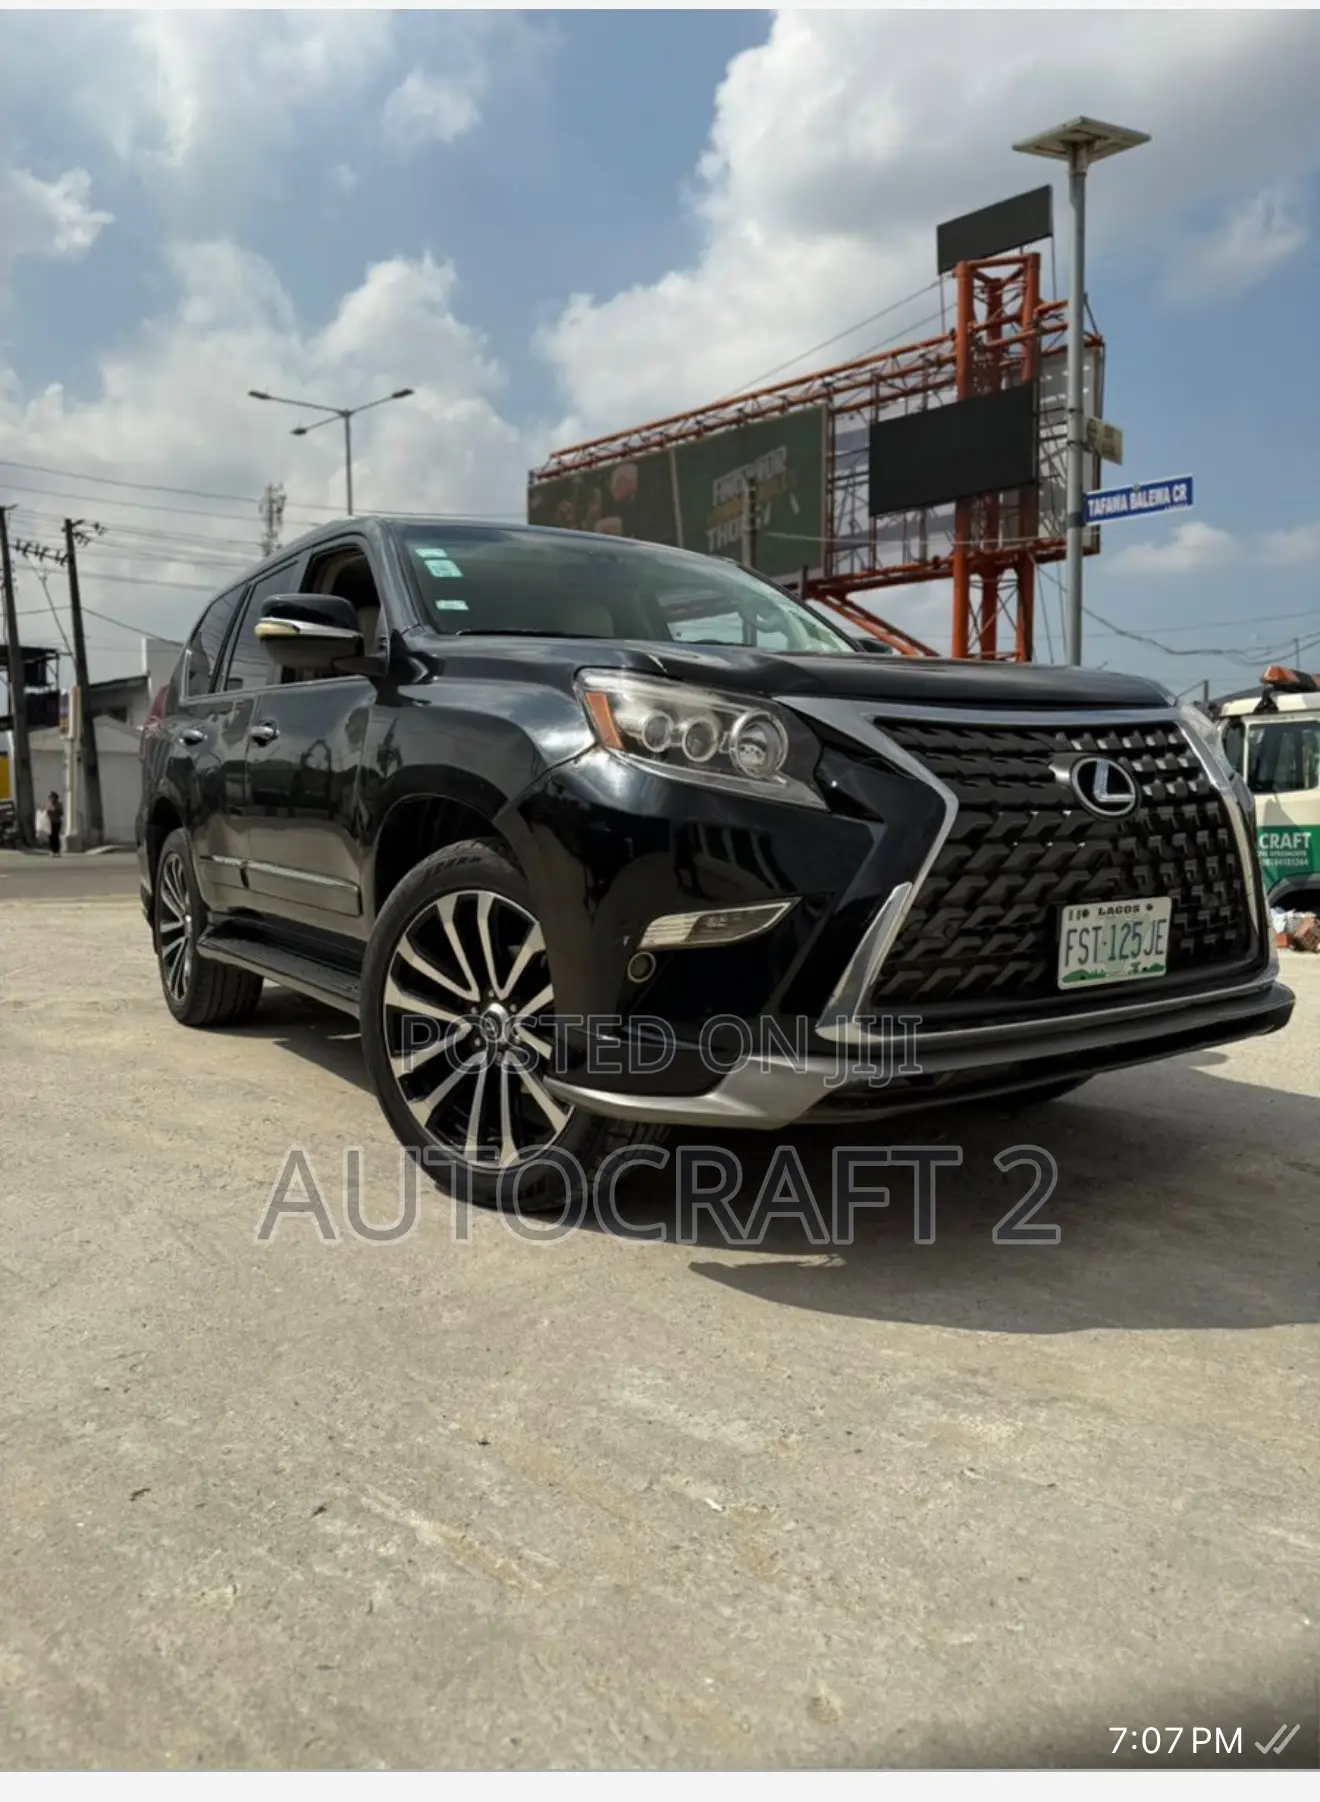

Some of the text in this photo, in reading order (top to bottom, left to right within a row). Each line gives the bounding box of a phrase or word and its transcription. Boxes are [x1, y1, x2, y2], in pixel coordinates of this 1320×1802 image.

[1172, 483, 1188, 502] CR
[1259, 831, 1312, 849] CRAFT
[1098, 903, 1141, 917] LAGOS
